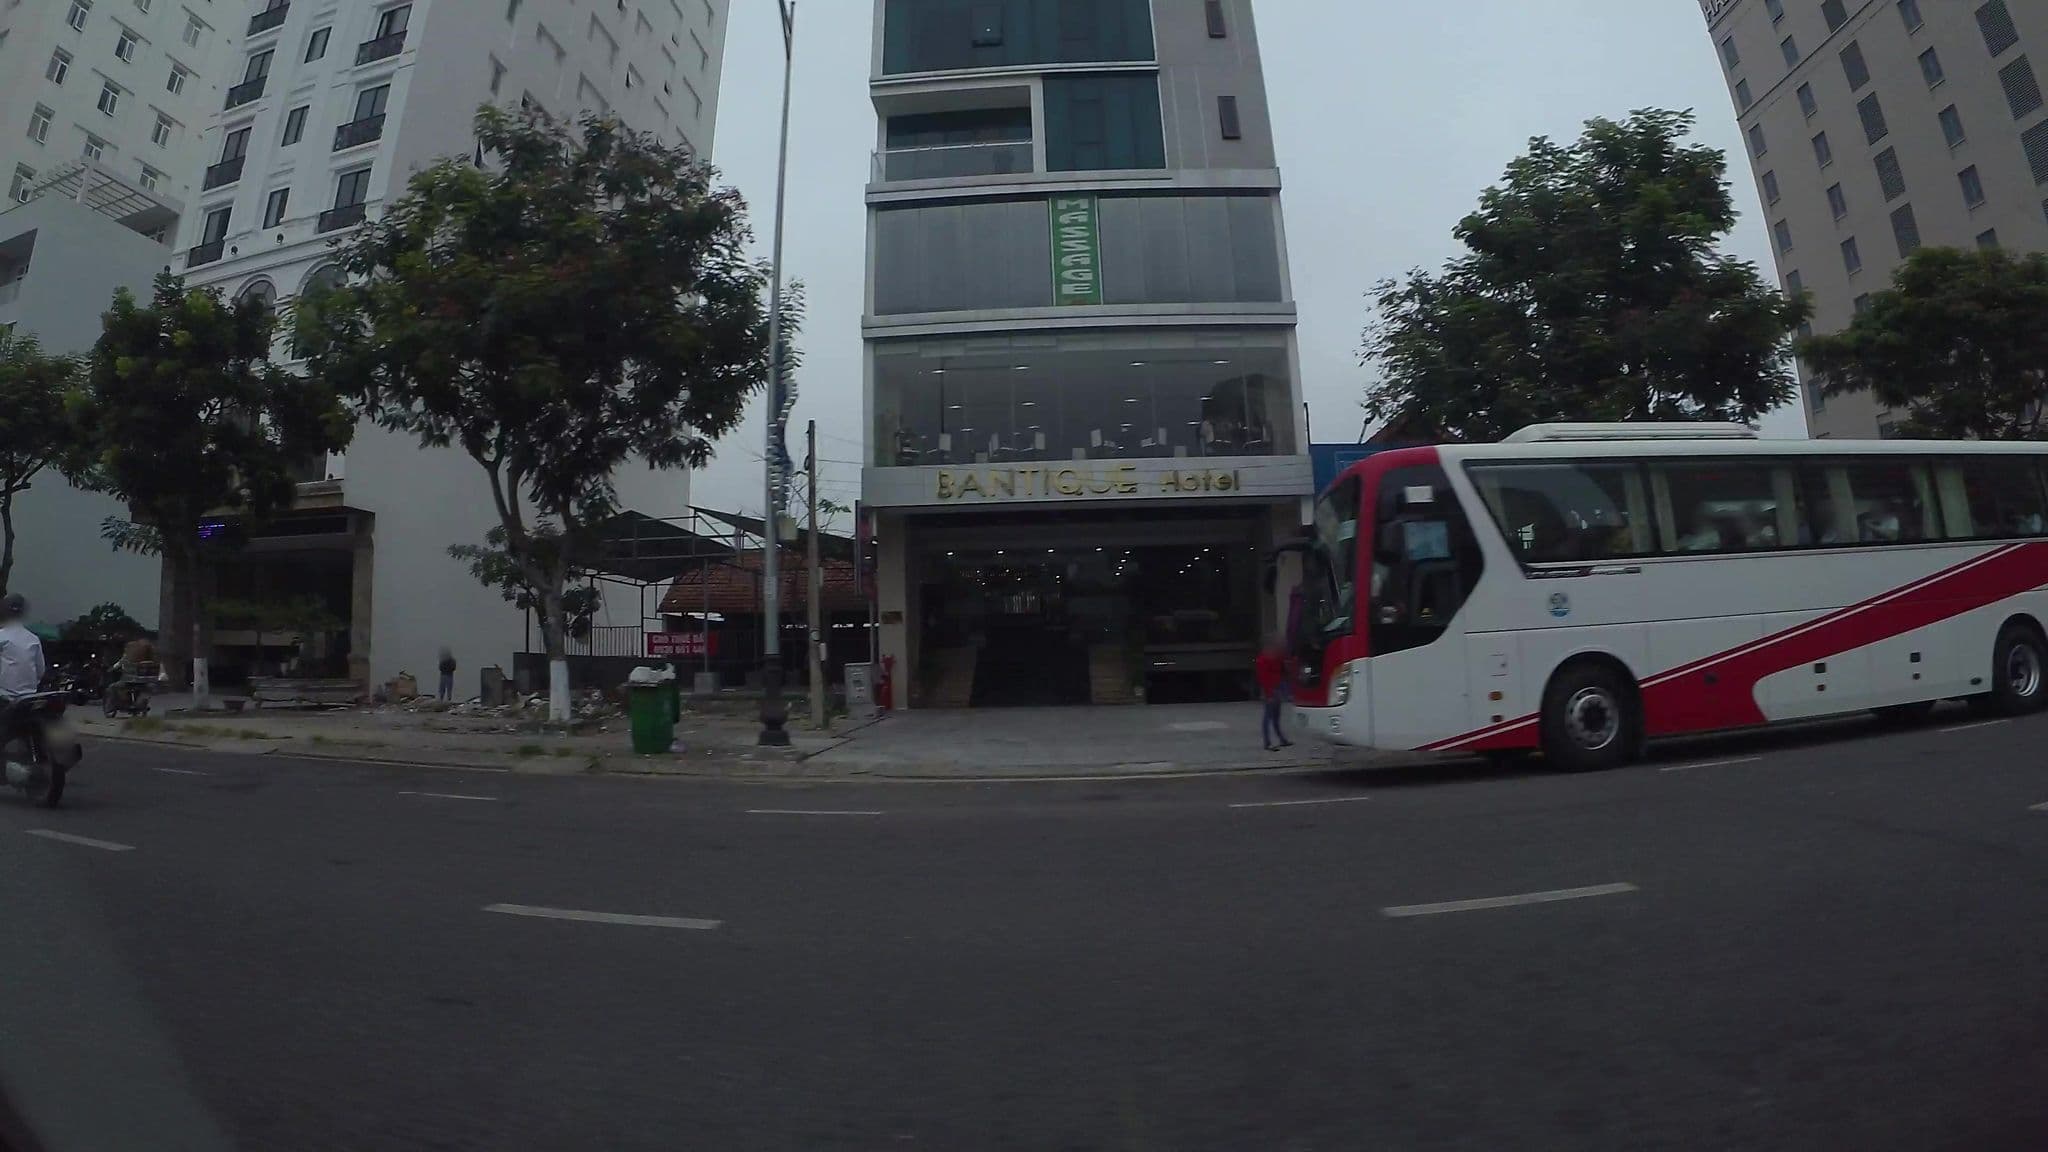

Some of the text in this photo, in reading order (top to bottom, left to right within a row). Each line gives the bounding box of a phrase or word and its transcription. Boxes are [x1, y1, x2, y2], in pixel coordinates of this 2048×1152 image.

[1057, 198, 1093, 295] MASSAGE
[937, 463, 1240, 499] BANTIQUE Hotel
